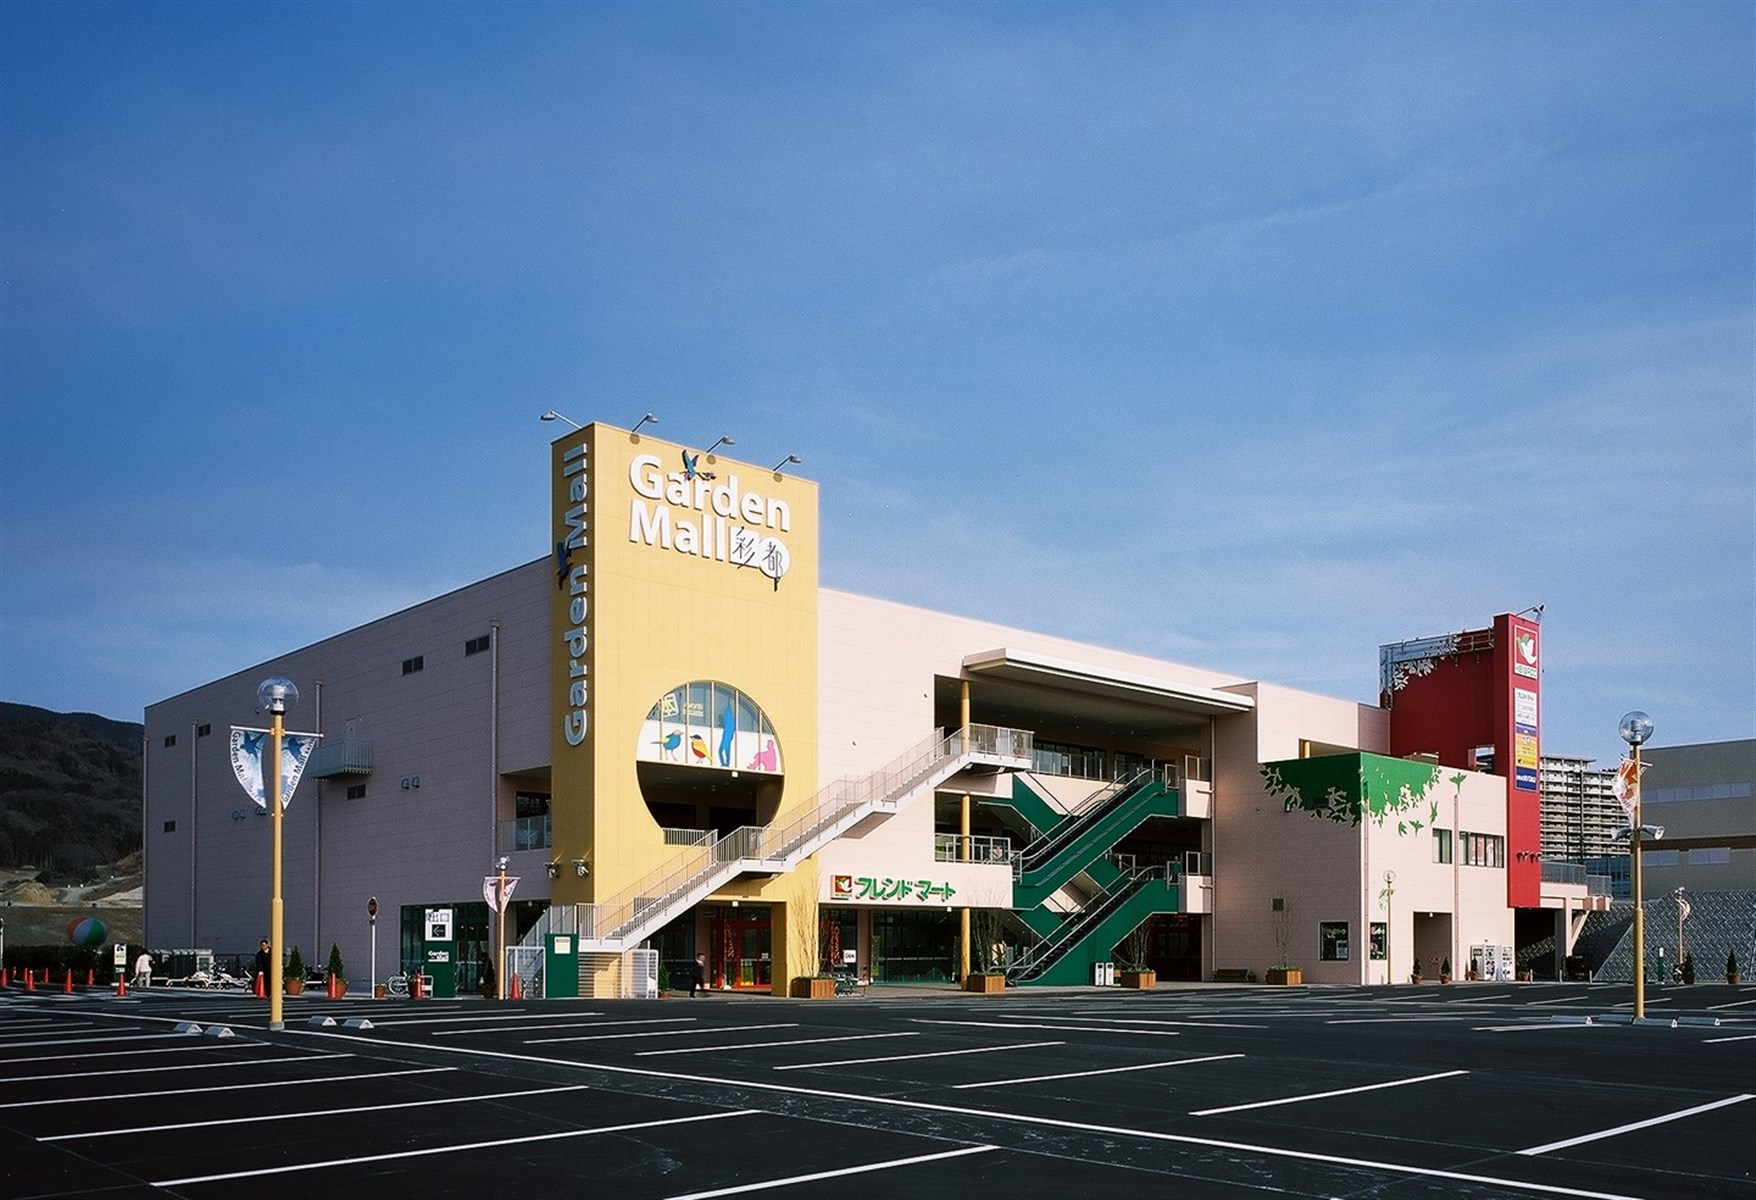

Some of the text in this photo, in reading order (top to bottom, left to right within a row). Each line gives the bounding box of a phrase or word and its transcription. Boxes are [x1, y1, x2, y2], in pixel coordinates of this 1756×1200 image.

[629, 453, 791, 532] Garden
[629, 500, 726, 562] Mall
[732, 526, 784, 592] 彩都
[564, 443, 588, 746] Garden Mall
[231, 731, 241, 764] Garden
[282, 775, 299, 802] Garden
[293, 754, 307, 775] Mall
[854, 877, 957, 901] フレンドマート
